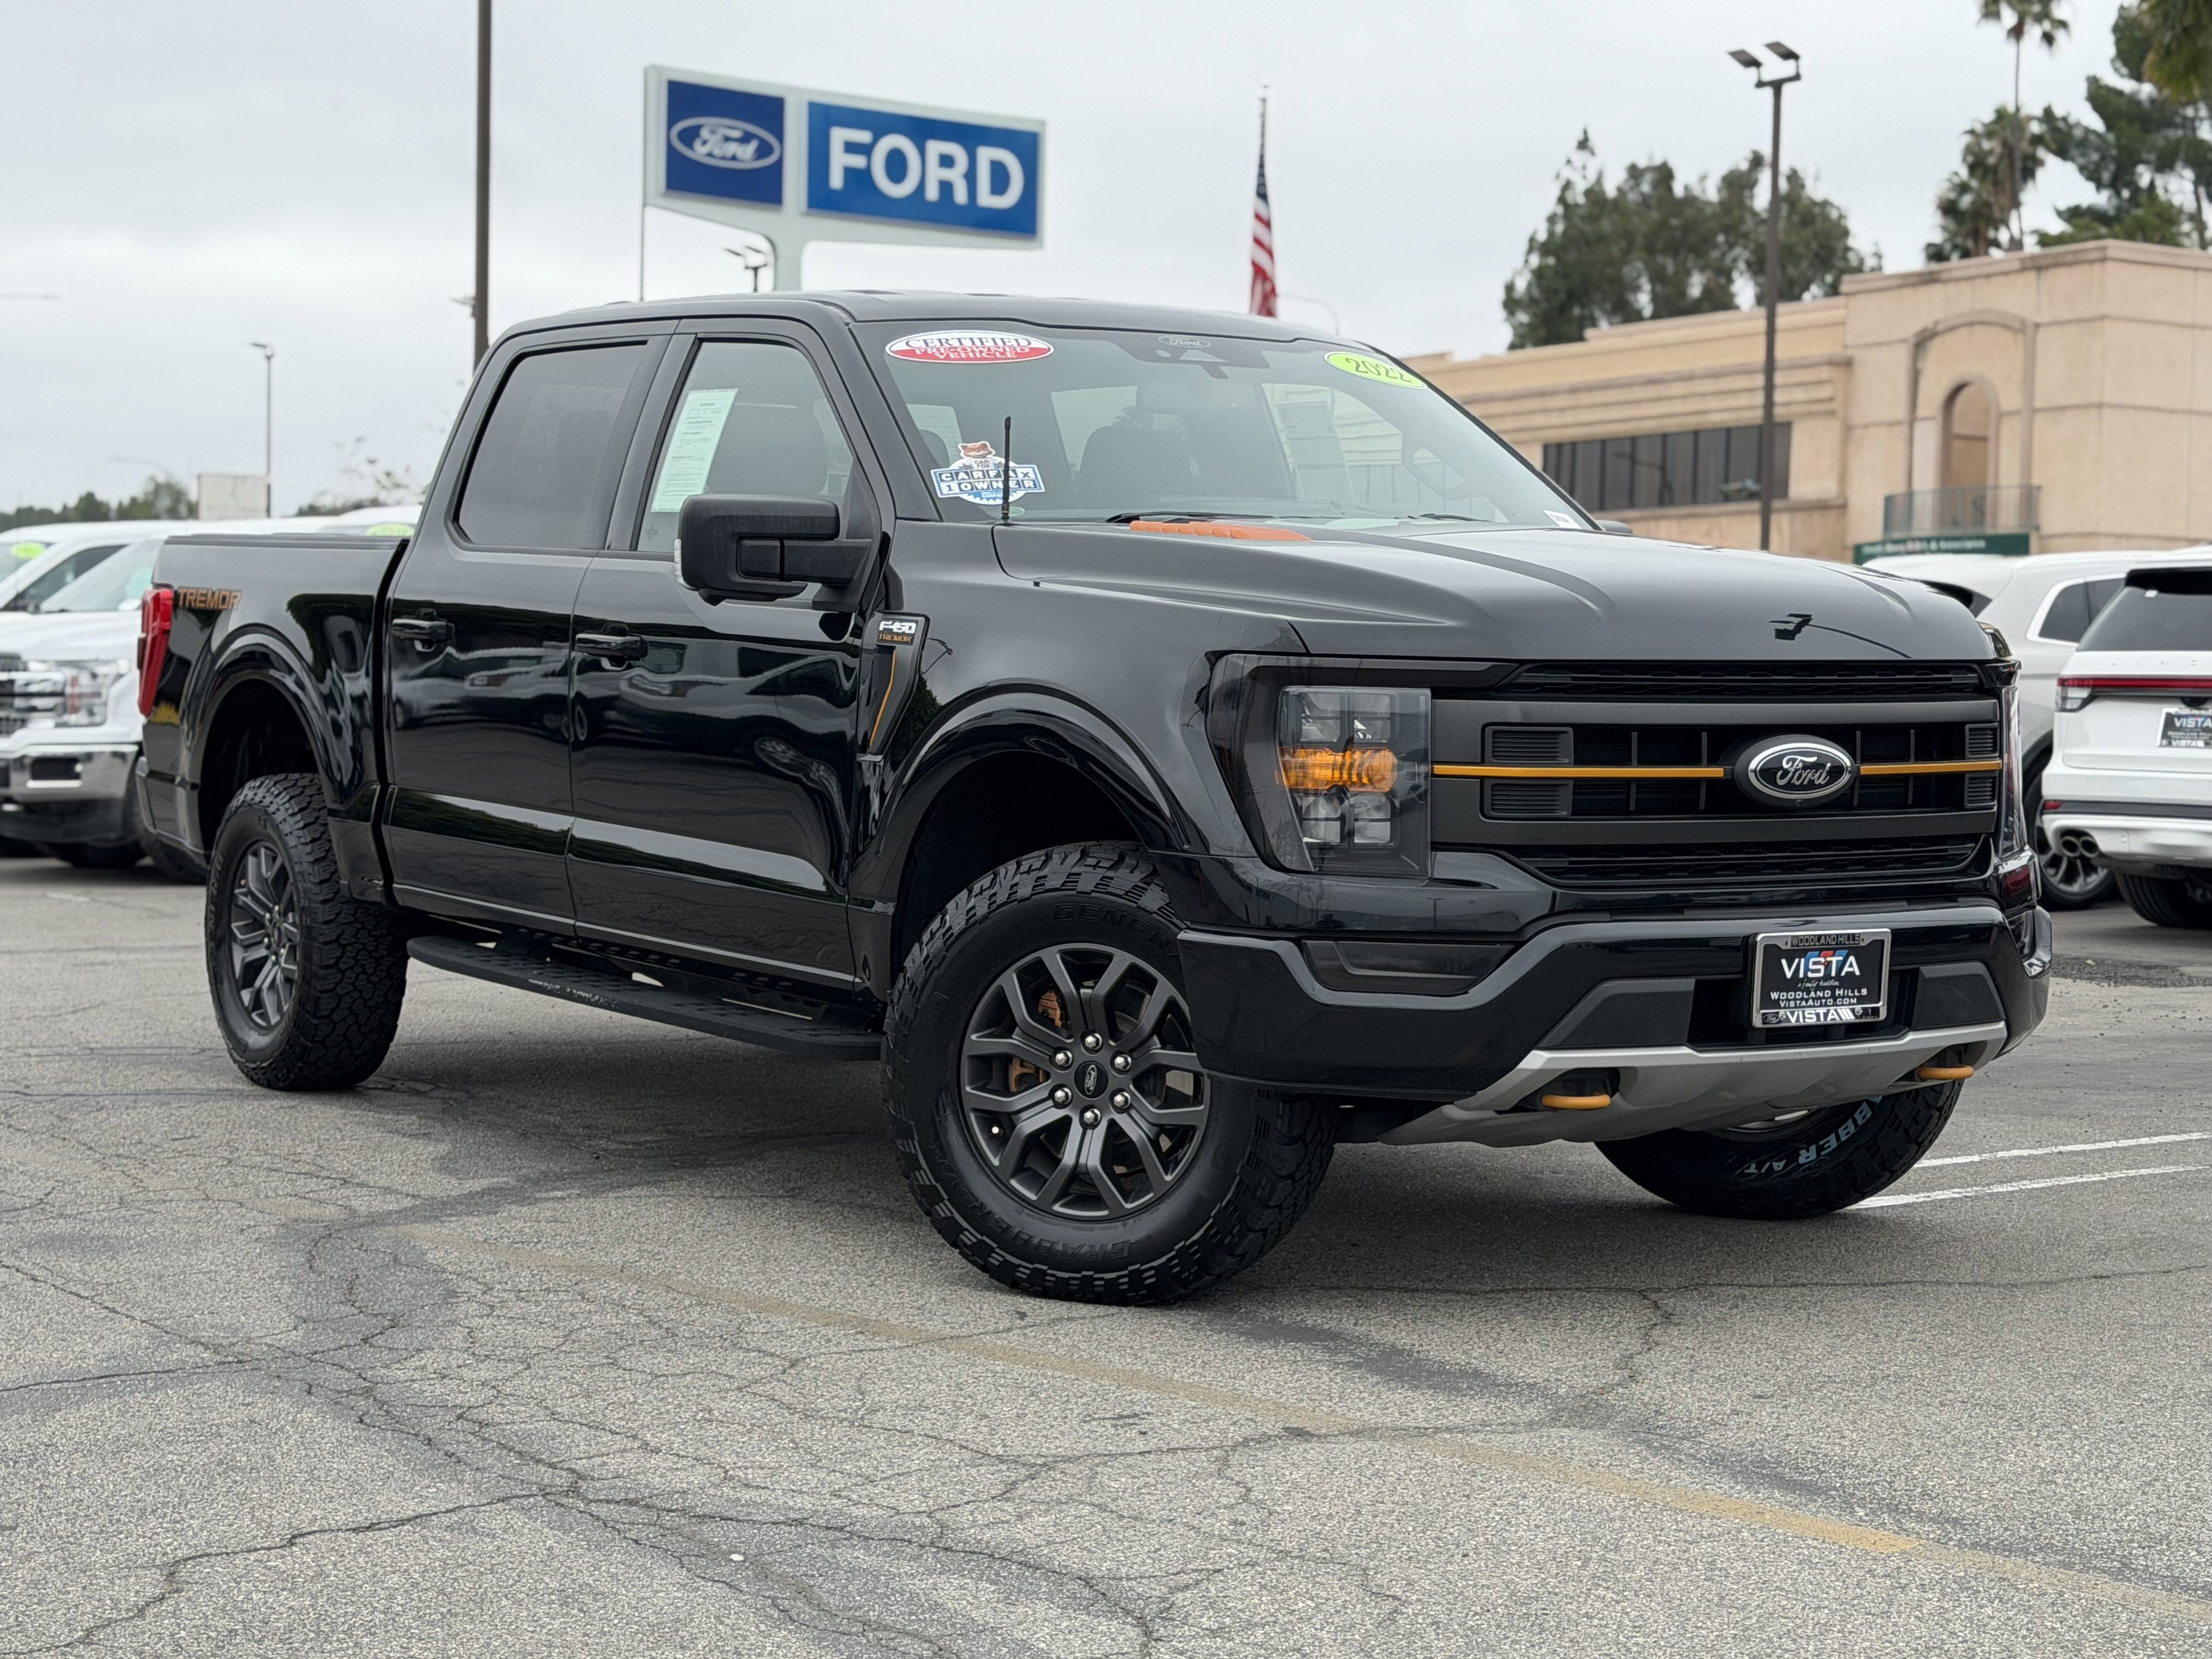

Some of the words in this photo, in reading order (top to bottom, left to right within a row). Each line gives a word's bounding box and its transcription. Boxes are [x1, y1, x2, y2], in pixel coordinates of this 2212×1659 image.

[693, 125, 759, 161] Ford
[828, 126, 1024, 209] FORD
[905, 337, 1031, 348] CERTIFIED
[1169, 336, 1202, 346] Ford
[914, 346, 1030, 355] PRE-OWNED
[934, 351, 1017, 359] VEHICLE
[1345, 358, 1412, 383] 2022
[940, 470, 1032, 481] CARFAX
[960, 481, 1035, 491] OWNER
[177, 588, 241, 610] TREMOR
[879, 634, 912, 642] TREMOR
[2174, 717, 2212, 728] VISTA
[1776, 755, 1831, 785] Ford
[1791, 935, 1837, 946] WOODLAND
[1838, 934, 1860, 944] HILLS
[1781, 956, 1861, 979] VISTA
[1786, 1009, 1839, 1023] VISTA
[1798, 1096, 1883, 1164] BBER
[1744, 1159, 1787, 1173] A/T
